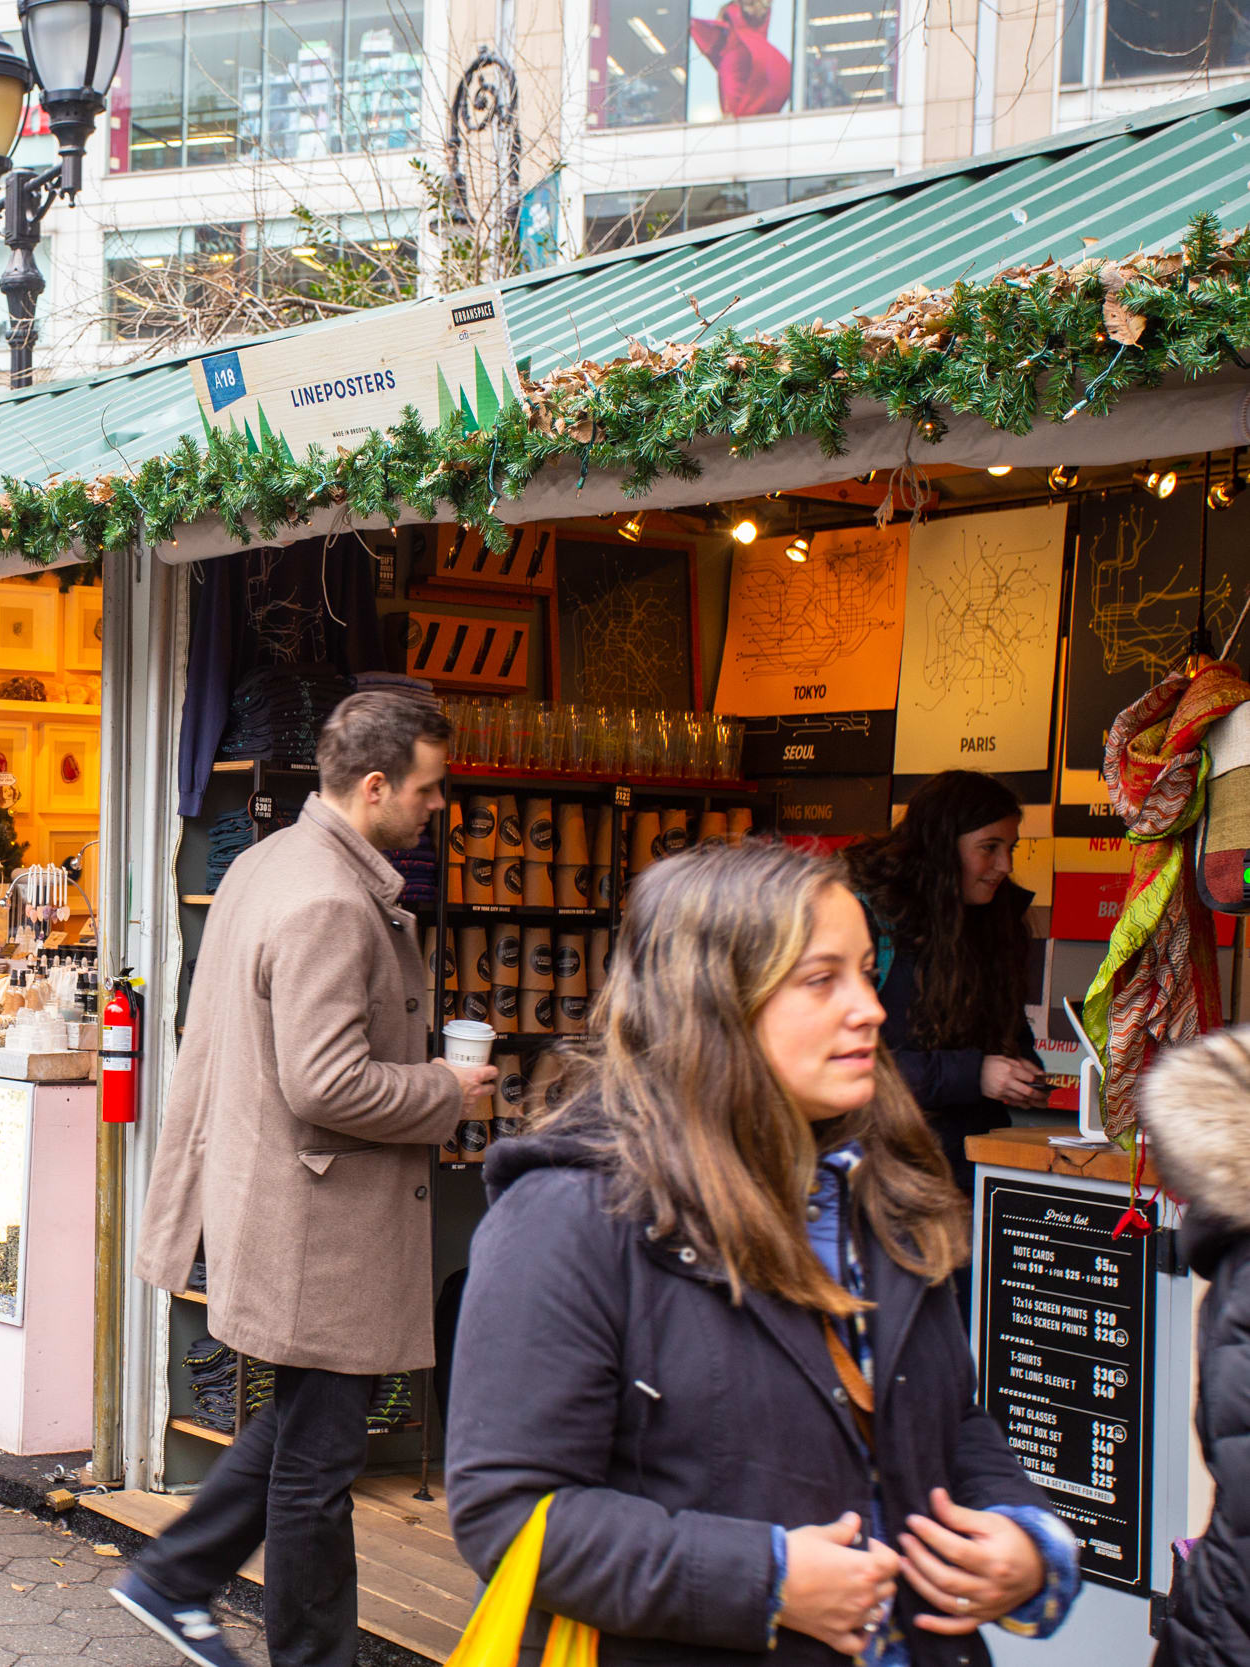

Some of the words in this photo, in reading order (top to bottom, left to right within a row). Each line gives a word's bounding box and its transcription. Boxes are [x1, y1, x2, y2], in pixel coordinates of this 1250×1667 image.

[453, 302, 494, 325] URBANSPACE
[458, 329, 470, 341] citi
[214, 367, 236, 390] A18
[290, 369, 396, 408] LINEPOSTERS
[332, 429, 345, 438] MADE
[793, 684, 827, 700] TOKYO
[782, 744, 815, 760] SEOUL
[960, 736, 996, 753] PARIS
[803, 804, 833, 820] KONG
[1089, 837, 1122, 851] NEW
[1044, 1208, 1071, 1223] Price
[1073, 1213, 1090, 1226] list
[1002, 1228, 1050, 1242] STATIONERY
[1013, 1245, 1031, 1258] NOTE
[1032, 1248, 1055, 1262] CARDS
[1028, 1262, 1043, 1274] $18
[1065, 1268, 1080, 1281] $25
[1103, 1275, 1118, 1288] $35
[1001, 1279, 1036, 1291] POSTERS
[1012, 1296, 1033, 1310] 12x16
[1034, 1300, 1061, 1315] SCREEN
[1062, 1305, 1088, 1321] PRINTS
[1094, 1309, 1117, 1326] $20
[1012, 1312, 1032, 1326] 18x24
[1034, 1316, 1060, 1331] SCREEN
[1061, 1321, 1088, 1337] PRINTS
[1000, 1333, 1035, 1346] APPAREL
[1011, 1350, 1042, 1367] T-SHIRTS
[1093, 1365, 1115, 1383] $30
[1010, 1366, 1024, 1379] NYC
[1025, 1369, 1043, 1383] LONG
[1044, 1374, 1070, 1390] SLEEVE
[1071, 1380, 1077, 1390] T
[1093, 1382, 1115, 1399] $40
[999, 1386, 1050, 1404] ACCESSORIES
[1009, 1404, 1025, 1417] PINT
[1026, 1408, 1057, 1425] GLASSES
[1092, 1421, 1114, 1438] $12
[1008, 1421, 1032, 1436] 4-PINT
[1034, 1426, 1048, 1439] BOX
[1049, 1430, 1062, 1443] SET
[1092, 1438, 1114, 1455] $40
[1008, 1436, 1038, 1453] COASTER
[1040, 1443, 1058, 1458] SETS
[1091, 1454, 1114, 1472] $30
[1023, 1456, 1040, 1470] TOTE
[1041, 1459, 1055, 1474] BAG
[1082, 1487, 1093, 1496] FOR
